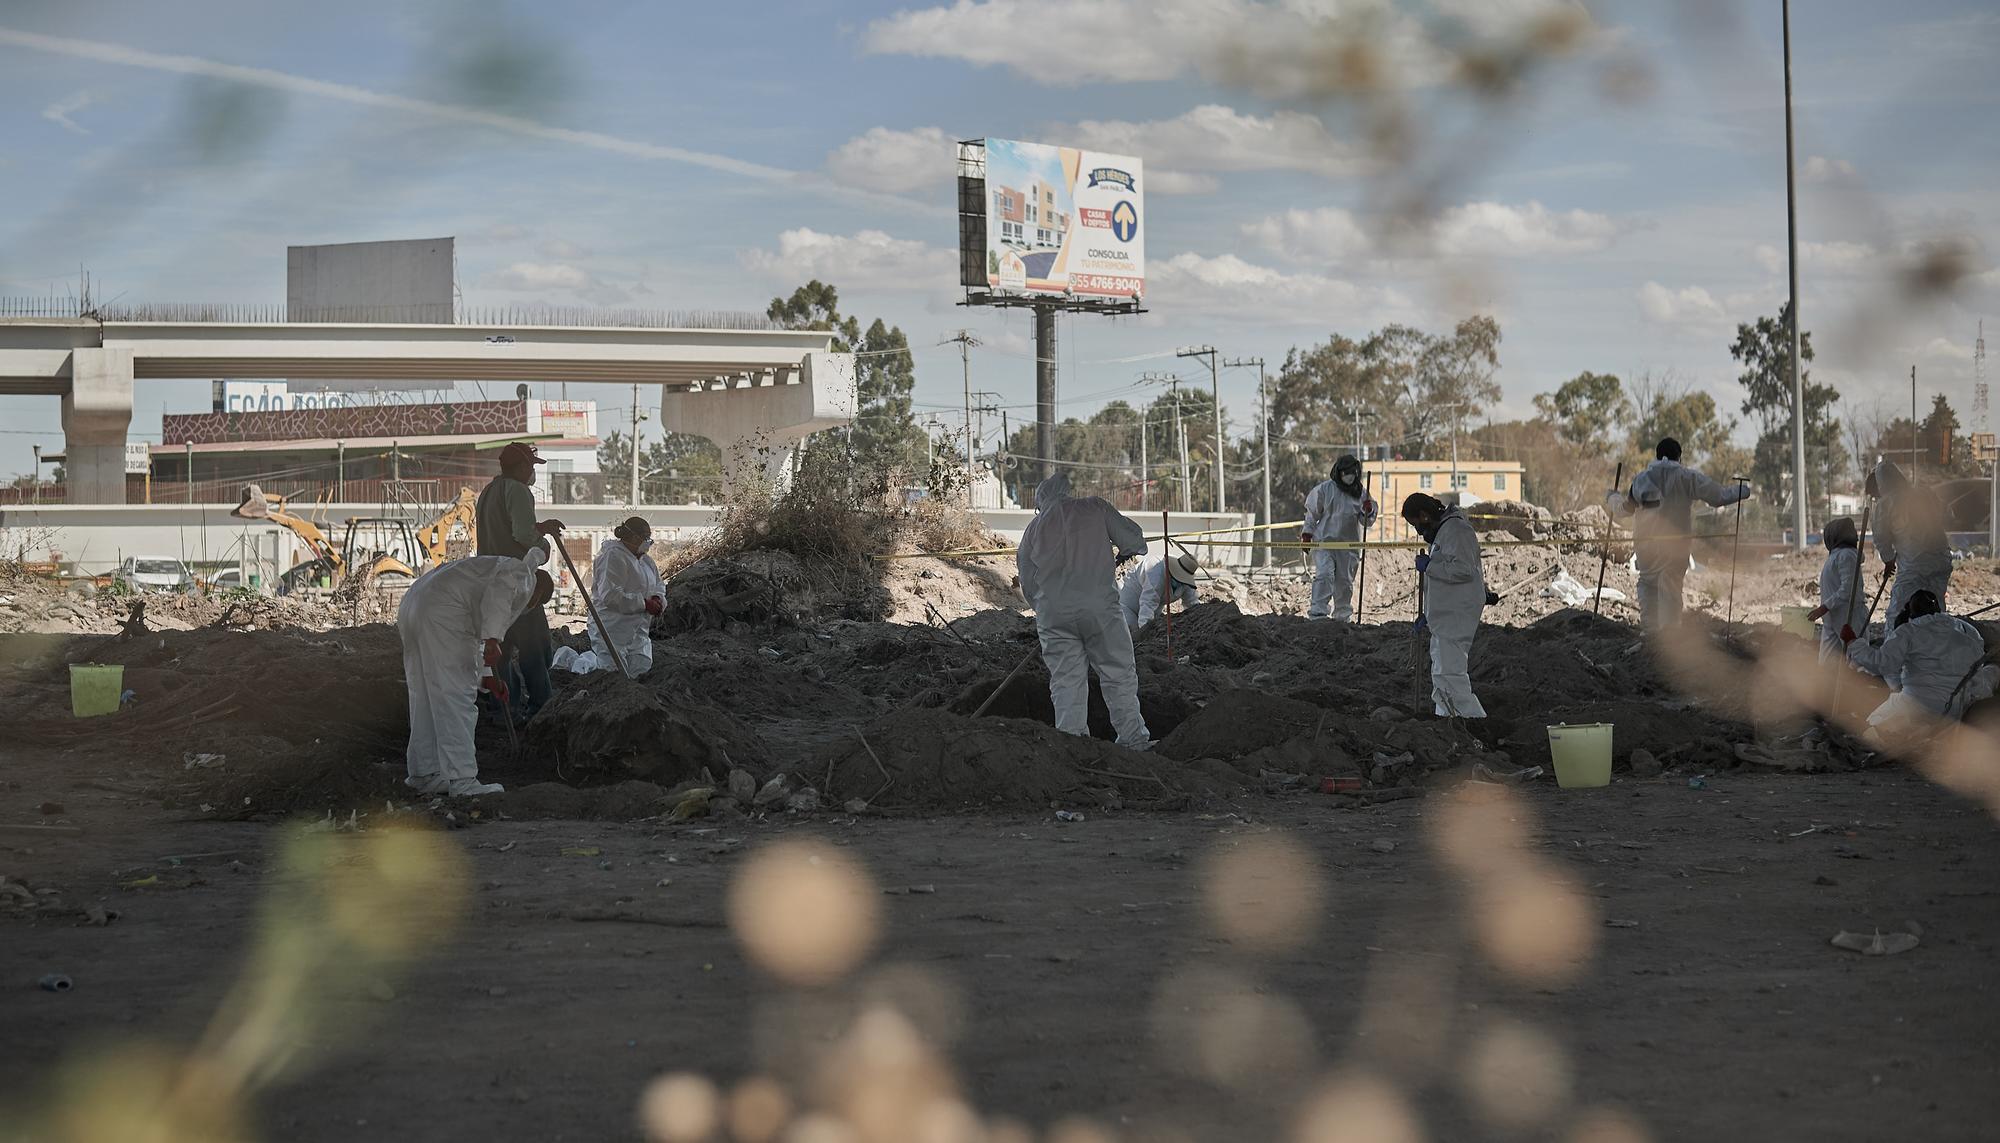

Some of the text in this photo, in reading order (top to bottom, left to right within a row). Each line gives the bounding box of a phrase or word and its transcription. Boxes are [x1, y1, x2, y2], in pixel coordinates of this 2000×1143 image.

[1094, 170, 1105, 181] LOS
[1087, 210, 1106, 219] CASAS
[1088, 248, 1129, 260] CONSOLIDA
[1081, 259, 1136, 271] TU PATRIMONIO
[1077, 275, 1140, 291] 55 4766-9040
